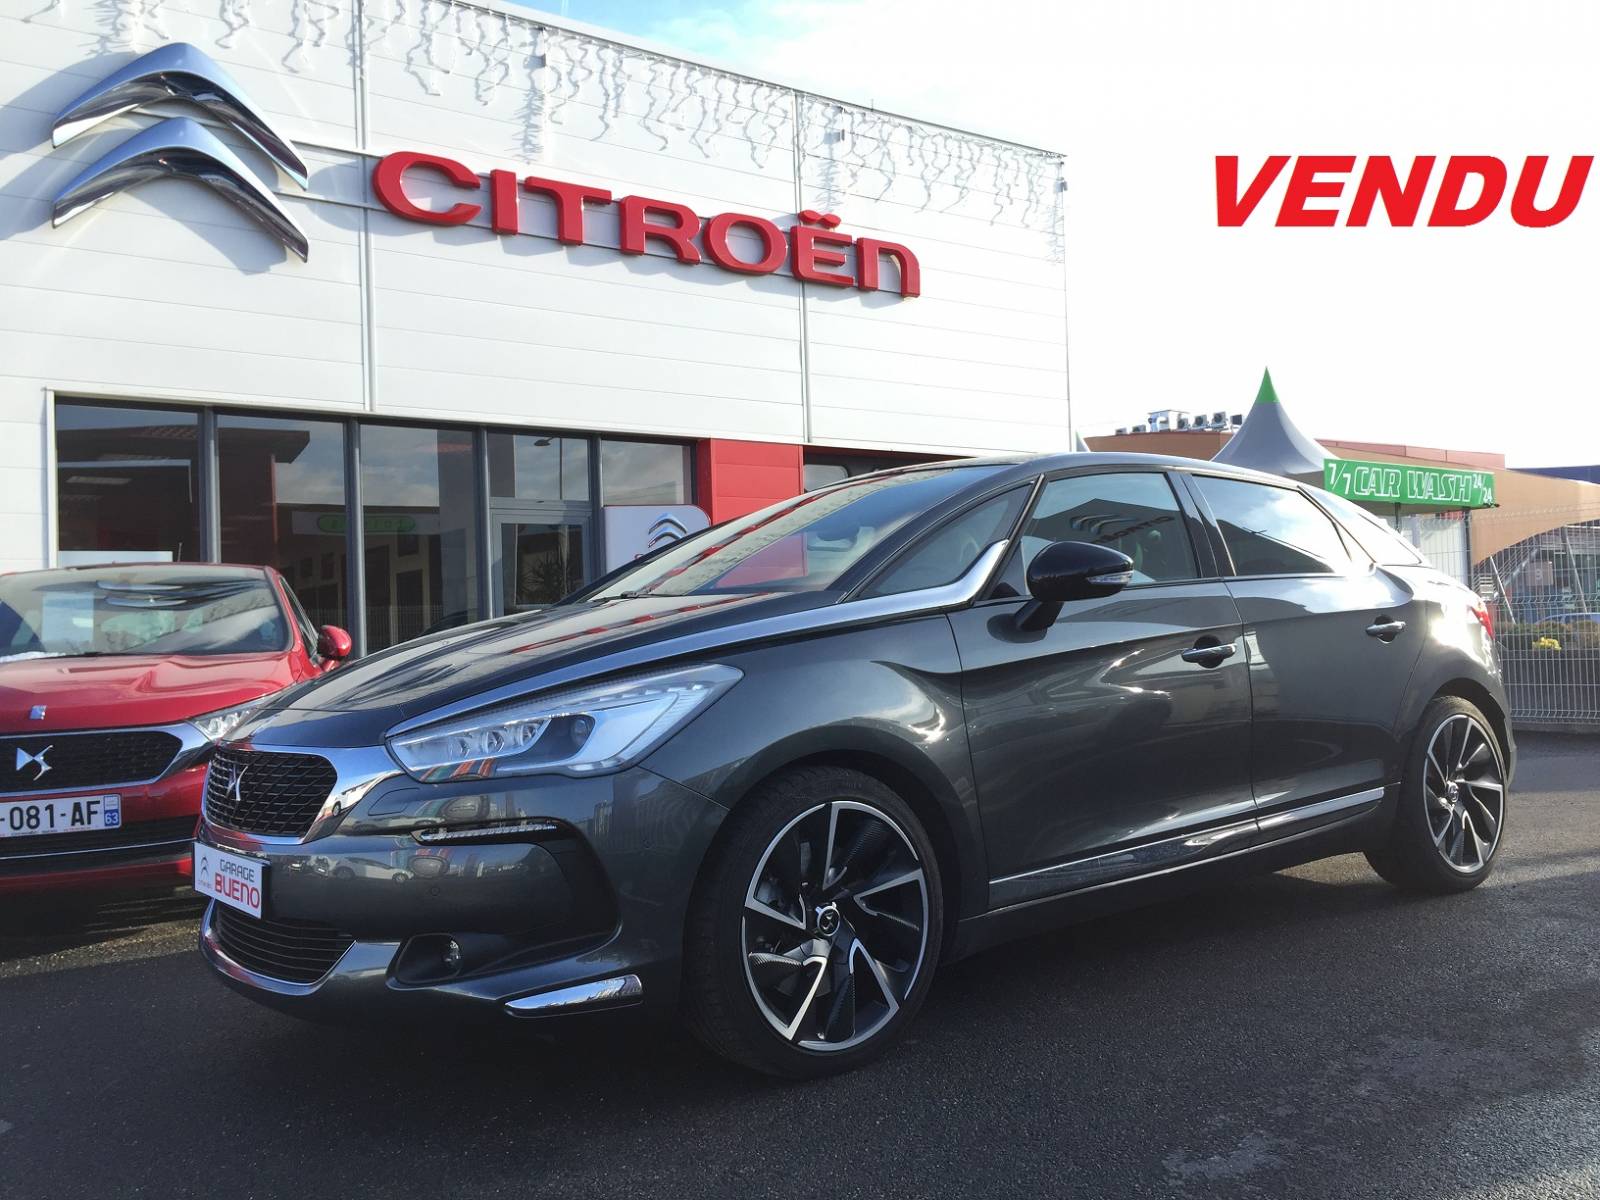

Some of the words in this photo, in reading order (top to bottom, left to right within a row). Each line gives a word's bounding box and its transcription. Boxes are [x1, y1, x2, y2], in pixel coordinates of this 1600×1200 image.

[371, 151, 921, 298] CITROËN
[1328, 463, 1351, 495] 7/7
[1353, 467, 1402, 497] CAR
[1407, 470, 1473, 502] WASH
[105, 811, 119, 825] 63
[219, 859, 255, 883] GARAGE
[214, 872, 260, 910] BUENO
